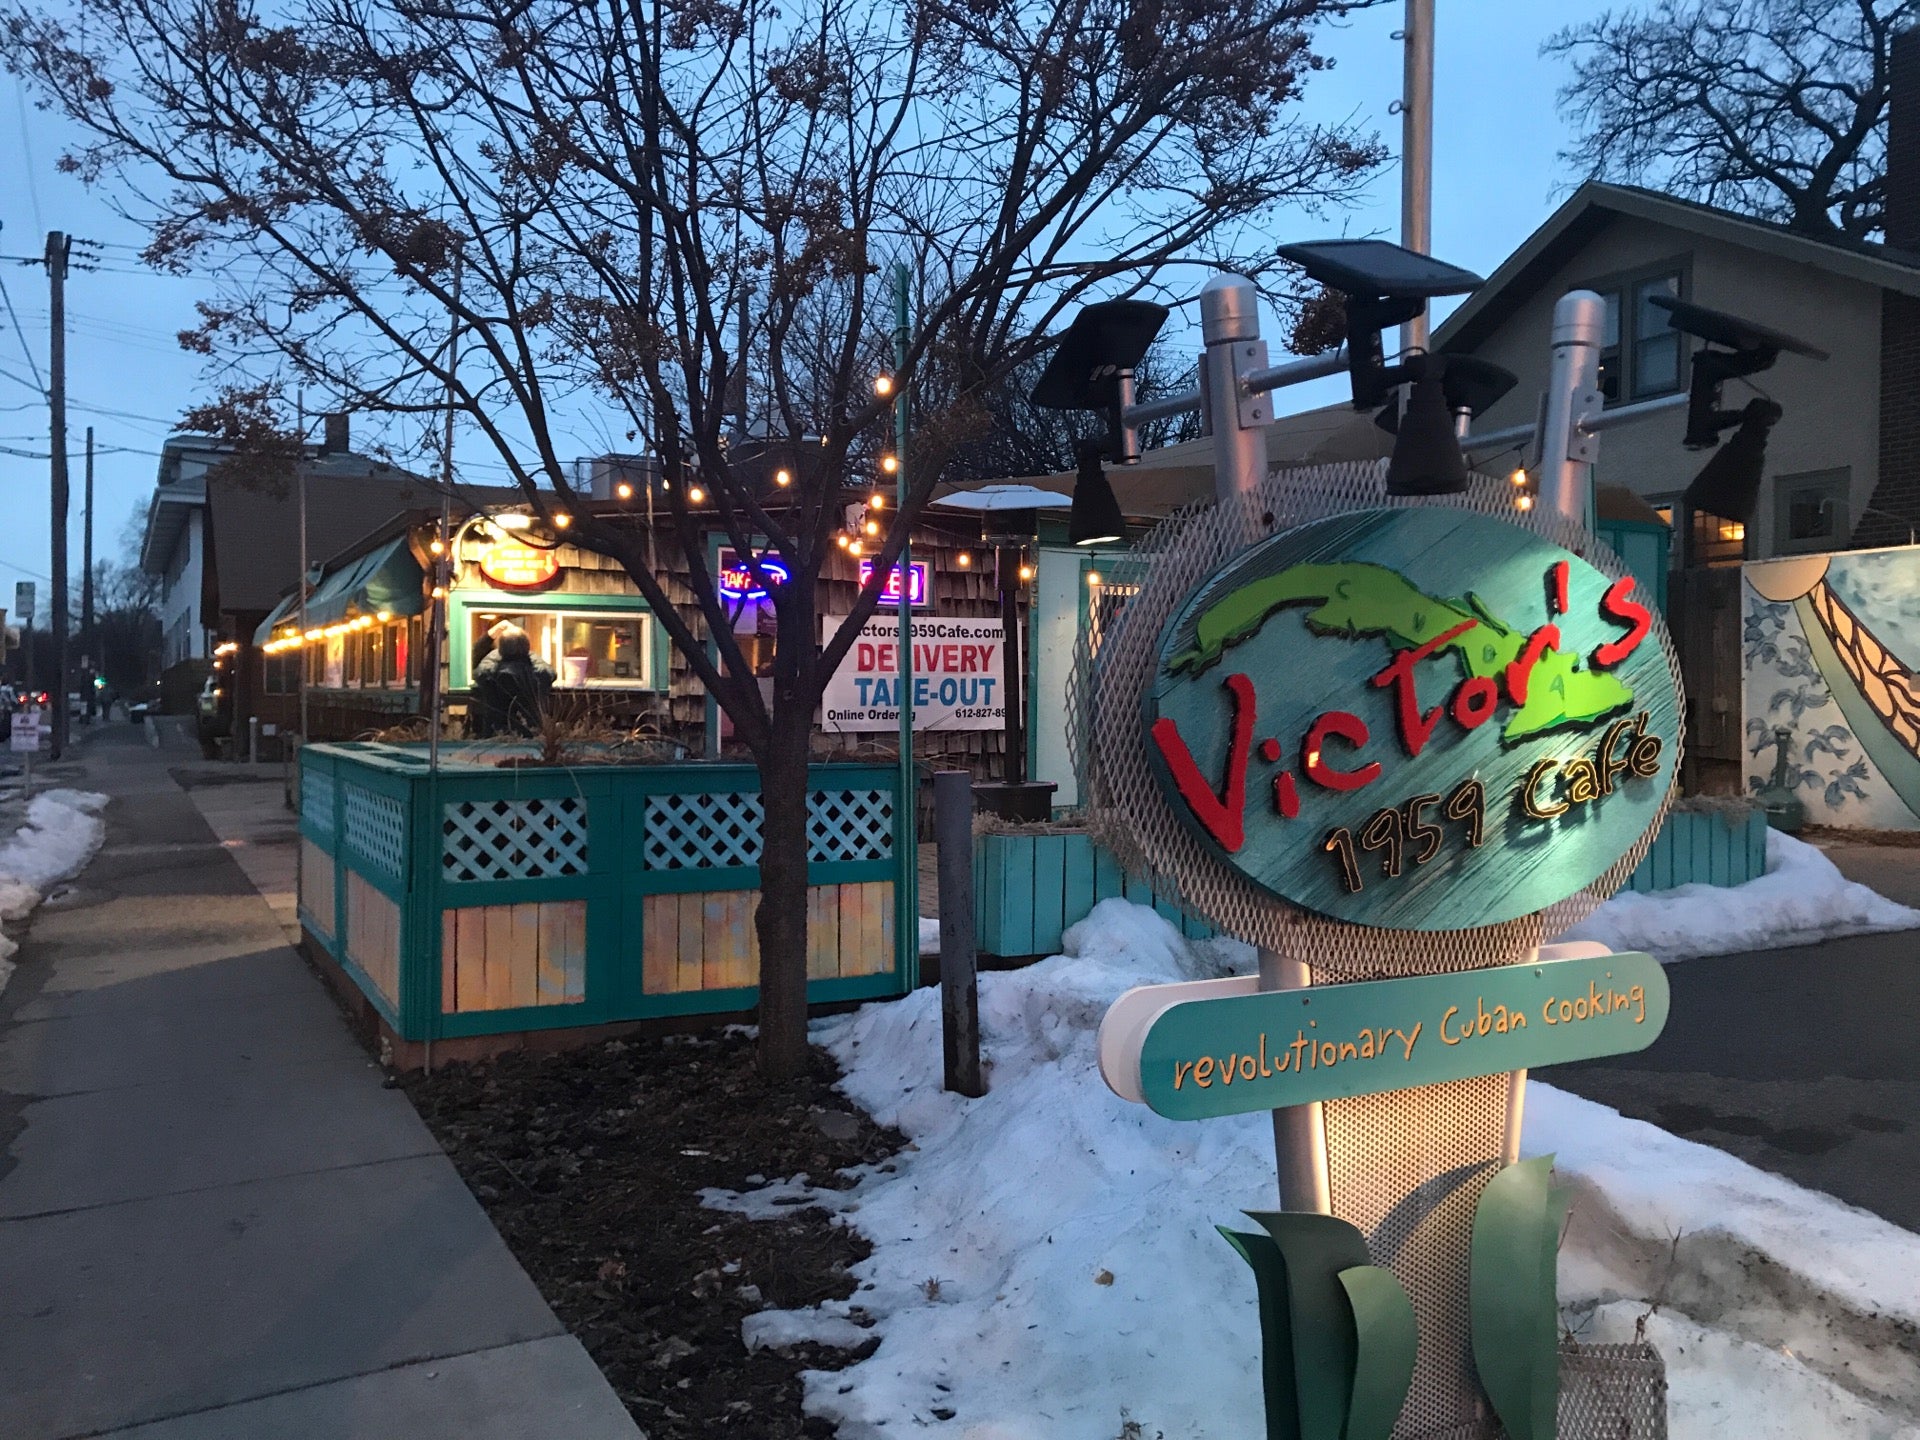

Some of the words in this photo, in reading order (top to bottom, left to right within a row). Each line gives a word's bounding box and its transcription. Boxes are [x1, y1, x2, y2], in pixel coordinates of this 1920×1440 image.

[857, 623, 1004, 639] ctors959Cafe.com
[827, 709, 865, 721] Online
[868, 709, 916, 722] Orderg
[955, 708, 1006, 719] 612-827-89
[1325, 778, 1487, 893] 1959
[1523, 711, 1663, 819] Café
[1174, 1019, 1423, 1090] revolutionary
[1440, 996, 1527, 1045] Cuban
[1543, 972, 1646, 1024] cooking
